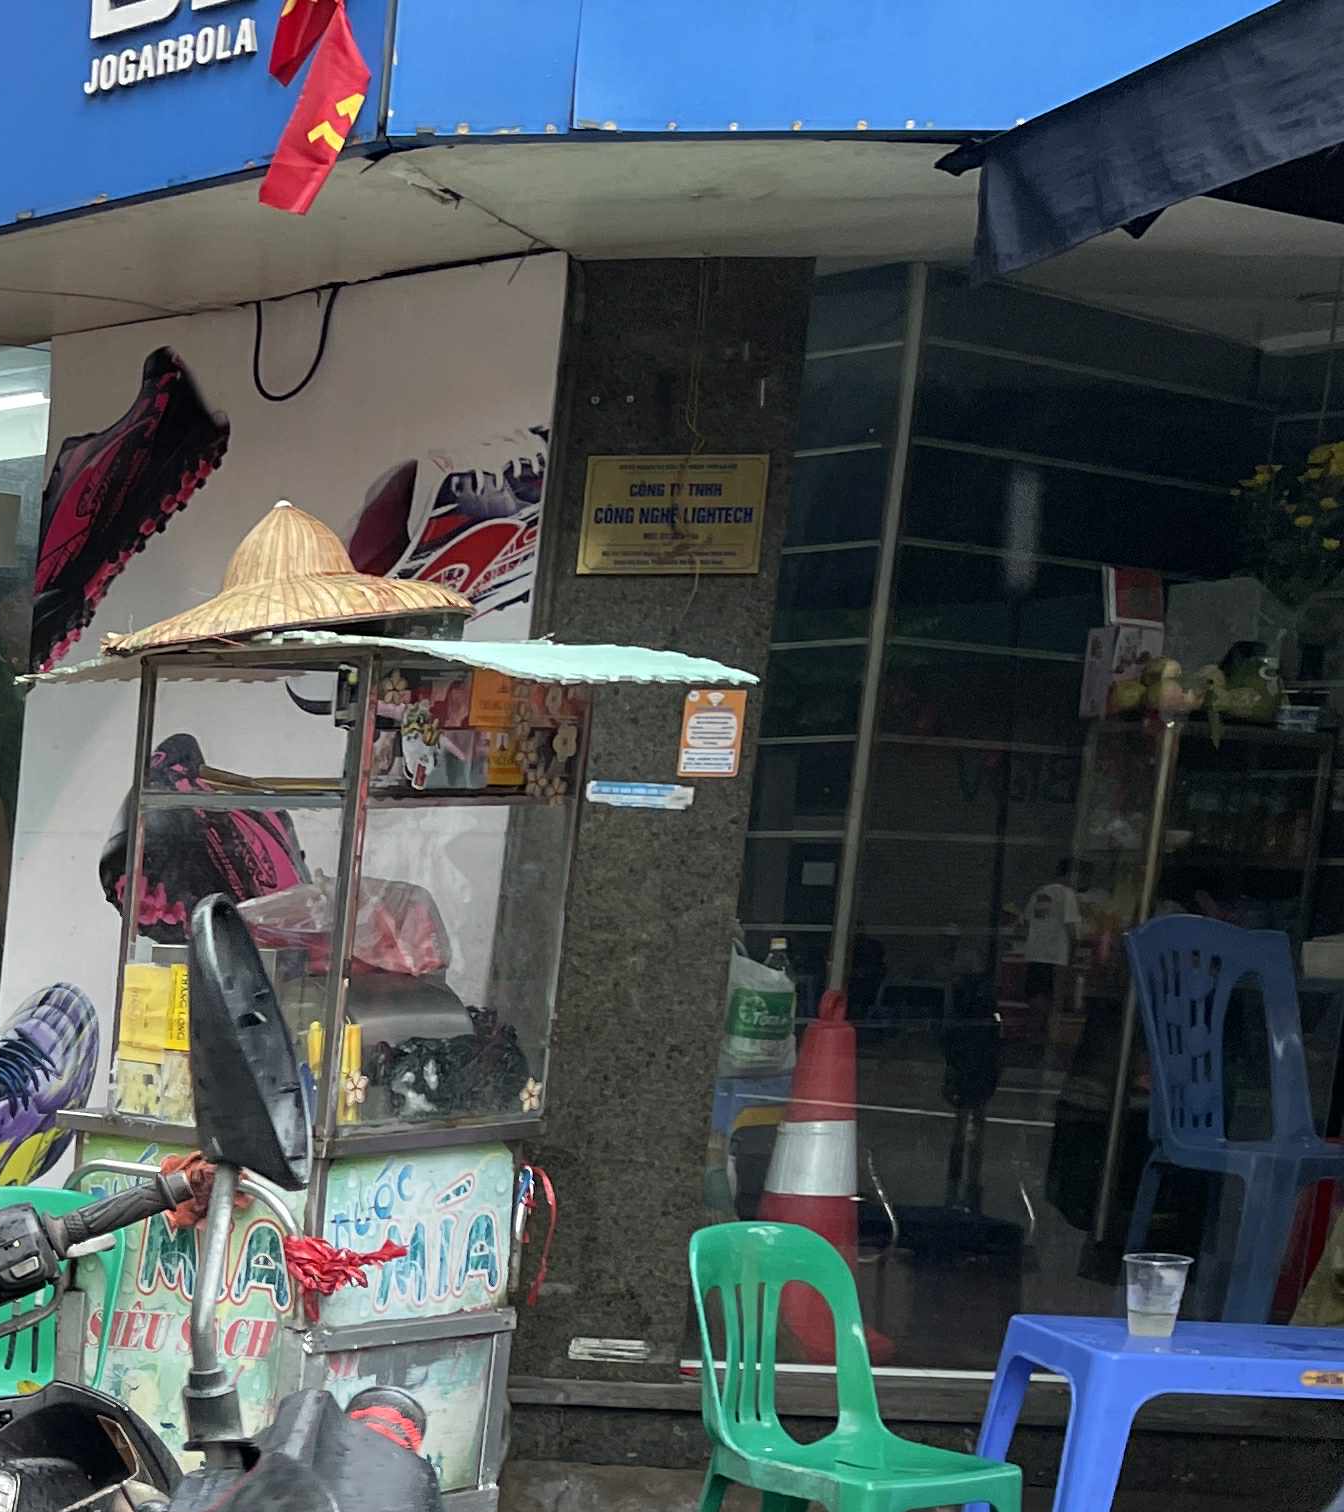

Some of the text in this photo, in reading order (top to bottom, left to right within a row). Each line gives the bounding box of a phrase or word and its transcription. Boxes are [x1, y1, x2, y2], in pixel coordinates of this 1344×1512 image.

[84, 18, 257, 96] JOGARBOLA
[594, 504, 634, 524] CÔNG
[683, 507, 753, 524] LIGHTECH
[630, 481, 664, 497] CÔNG
[688, 483, 722, 497] TNHH
[137, 1210, 292, 1312] MA
[375, 1172, 502, 1312] MÍA
[178, 1312, 280, 1360] SCH
